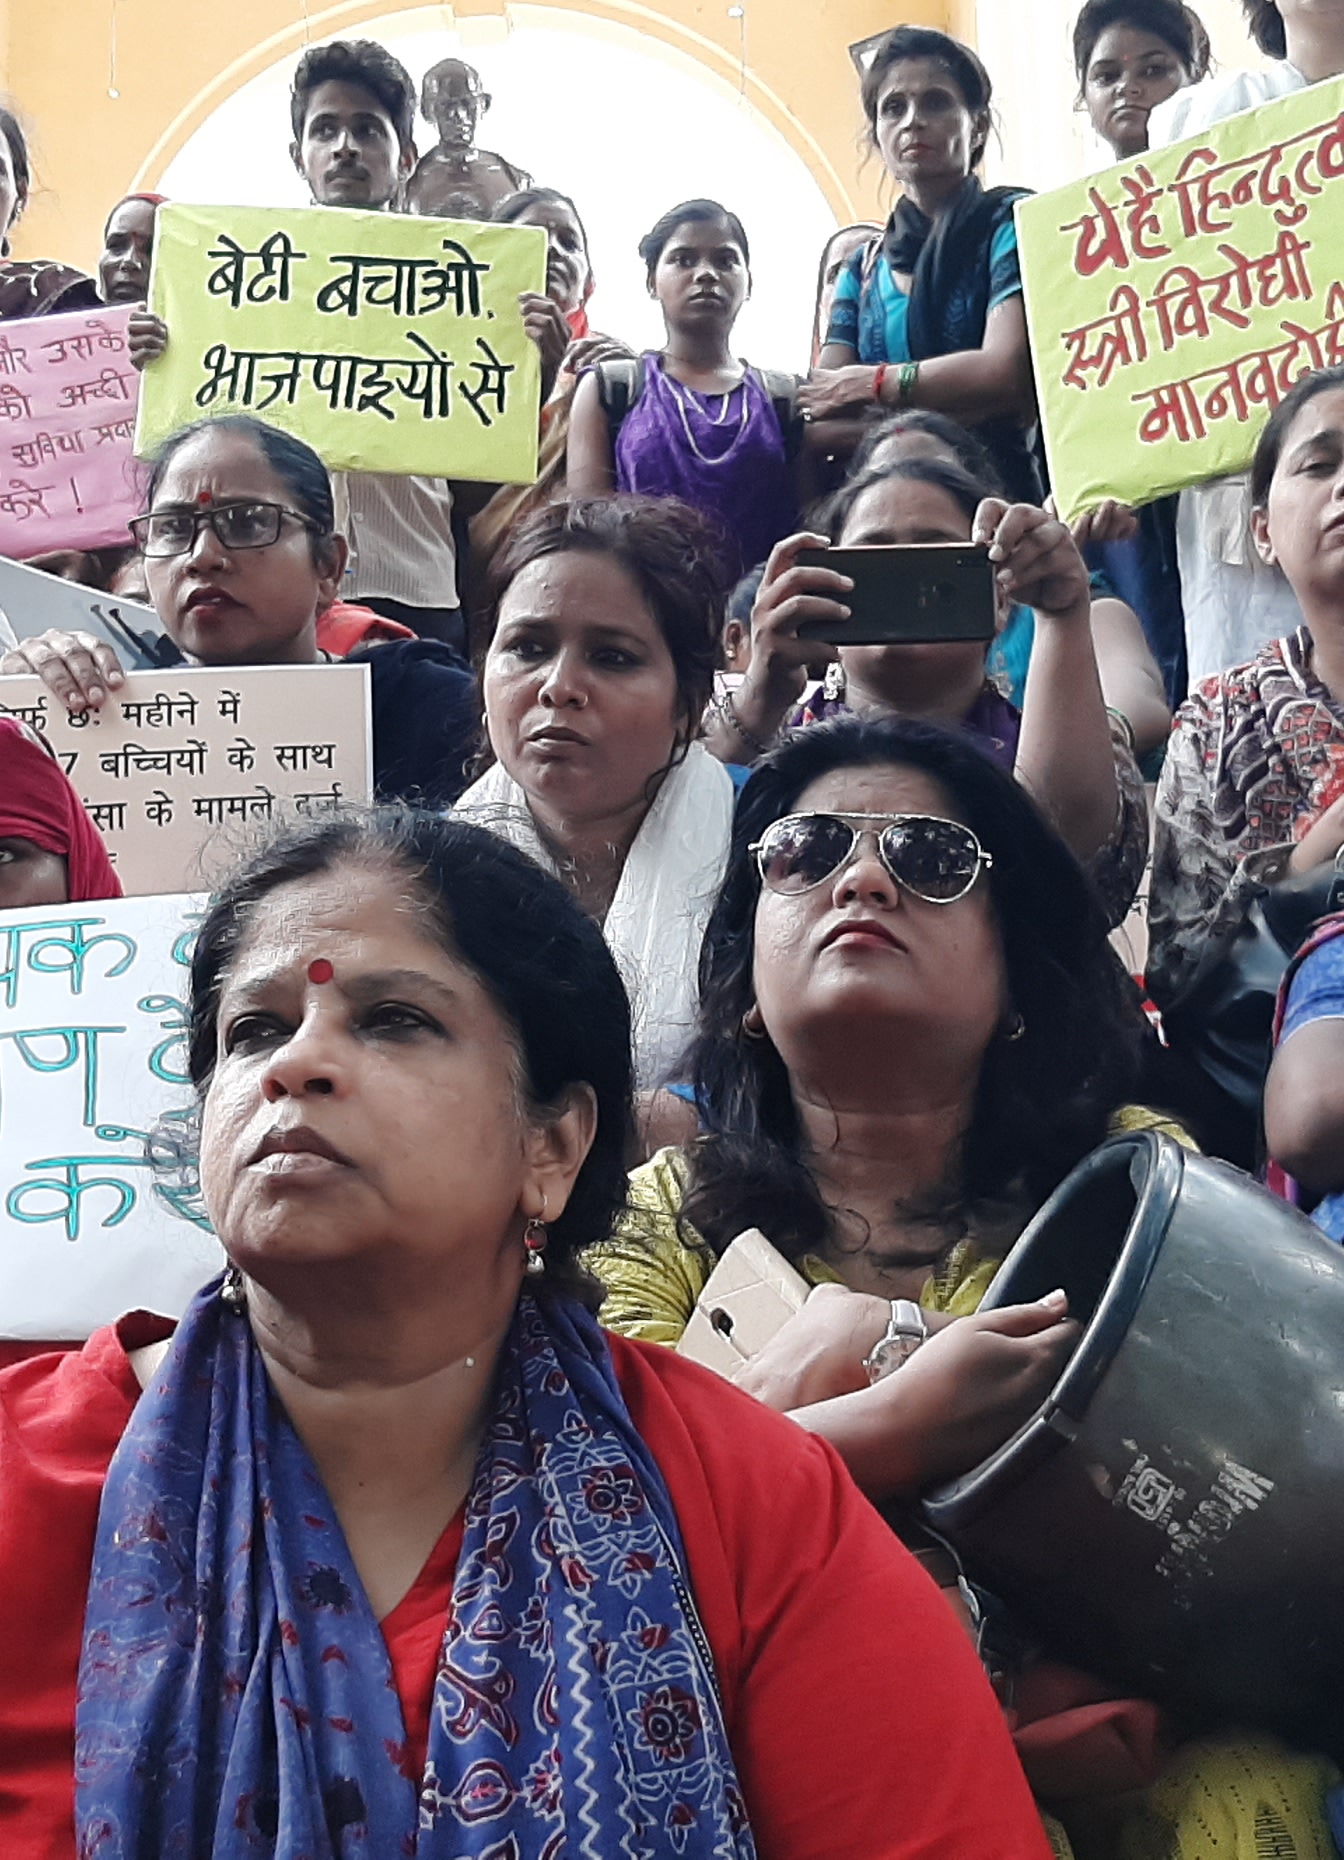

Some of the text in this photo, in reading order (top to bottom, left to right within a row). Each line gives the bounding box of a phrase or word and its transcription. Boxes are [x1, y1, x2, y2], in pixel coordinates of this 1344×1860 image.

[207, 231, 308, 309] बेटी
[40, 319, 125, 364] उसके
[195, 331, 515, 427] भाजपाइयों से
[11, 431, 85, 468] सुविधा
[121, 691, 200, 729] महीने
[218, 690, 242, 725] में
[99, 738, 209, 779] बच्चियों
[227, 737, 257, 774] के
[274, 743, 337, 772] साथ
[145, 790, 173, 828] के
[192, 785, 276, 825] मामले
